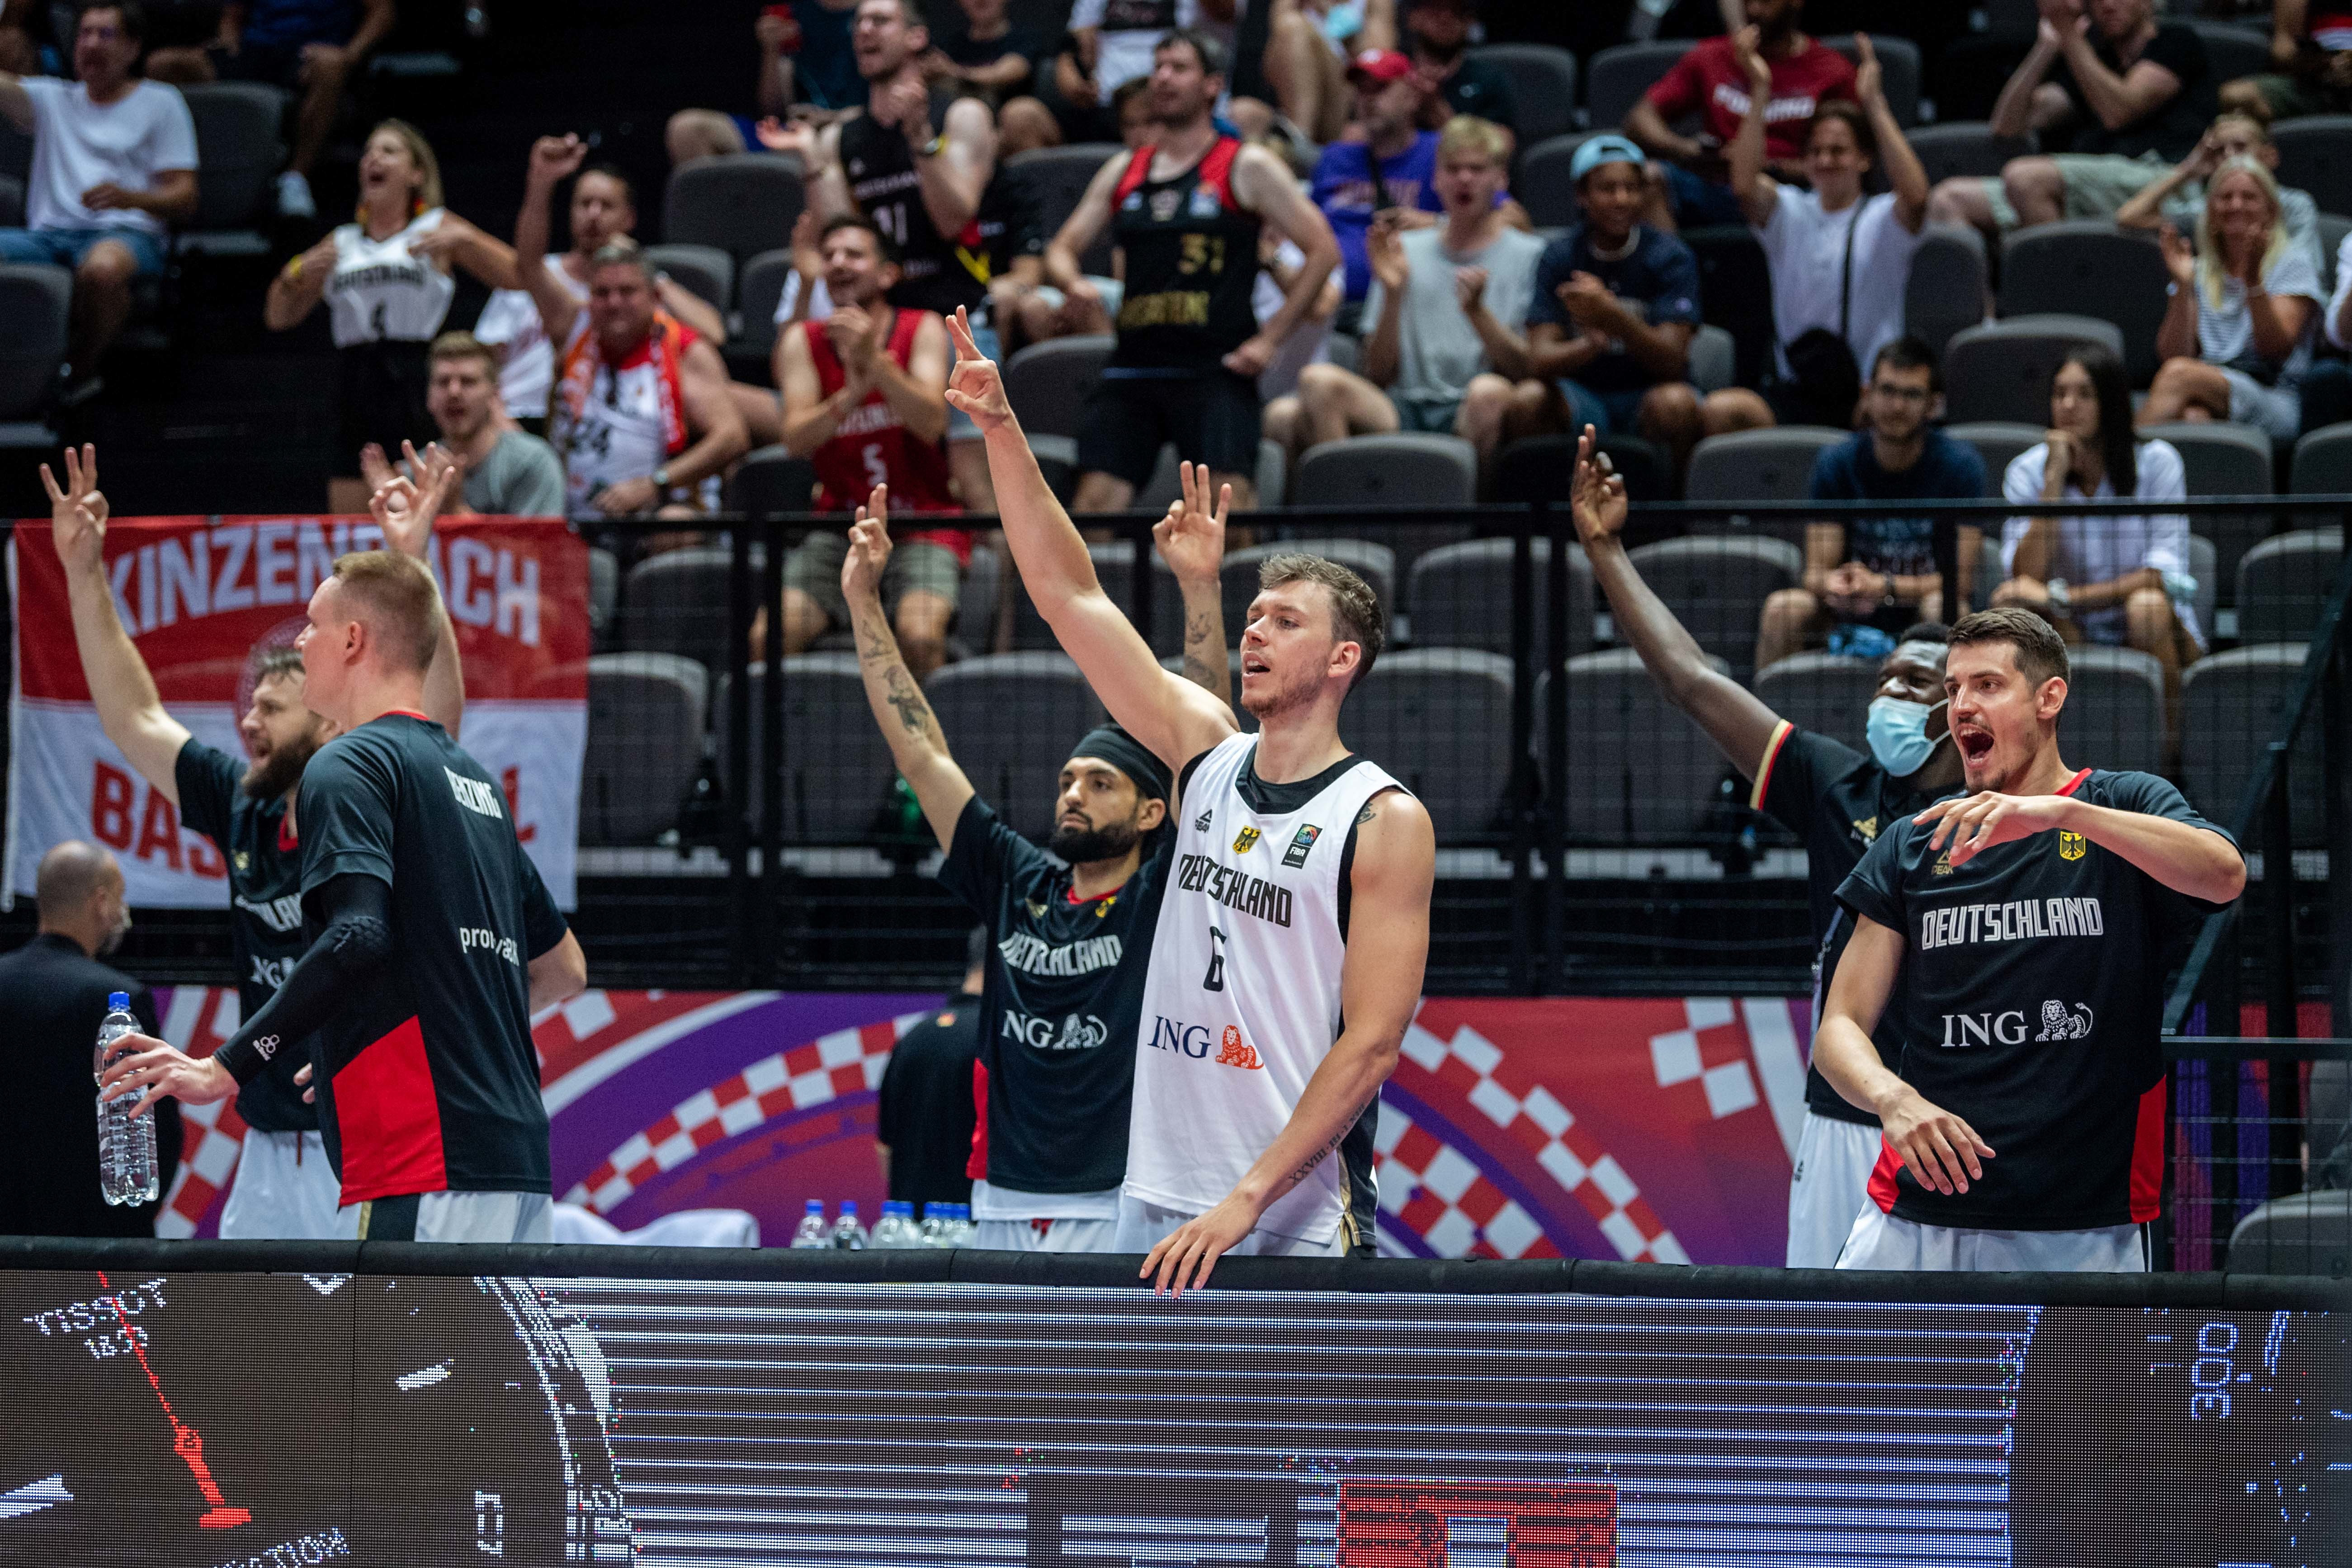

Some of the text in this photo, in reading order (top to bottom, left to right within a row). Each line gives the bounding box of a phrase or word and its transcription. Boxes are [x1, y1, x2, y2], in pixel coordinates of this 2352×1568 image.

[1289, 846, 1306, 857] FIBA
[1922, 897, 2104, 950] DEUTSCHLAND
[1203, 926, 1227, 992] 6
[1001, 1010, 1054, 1048] NG
[1148, 1015, 1212, 1059] ING
[1941, 1010, 2029, 1047] ING
